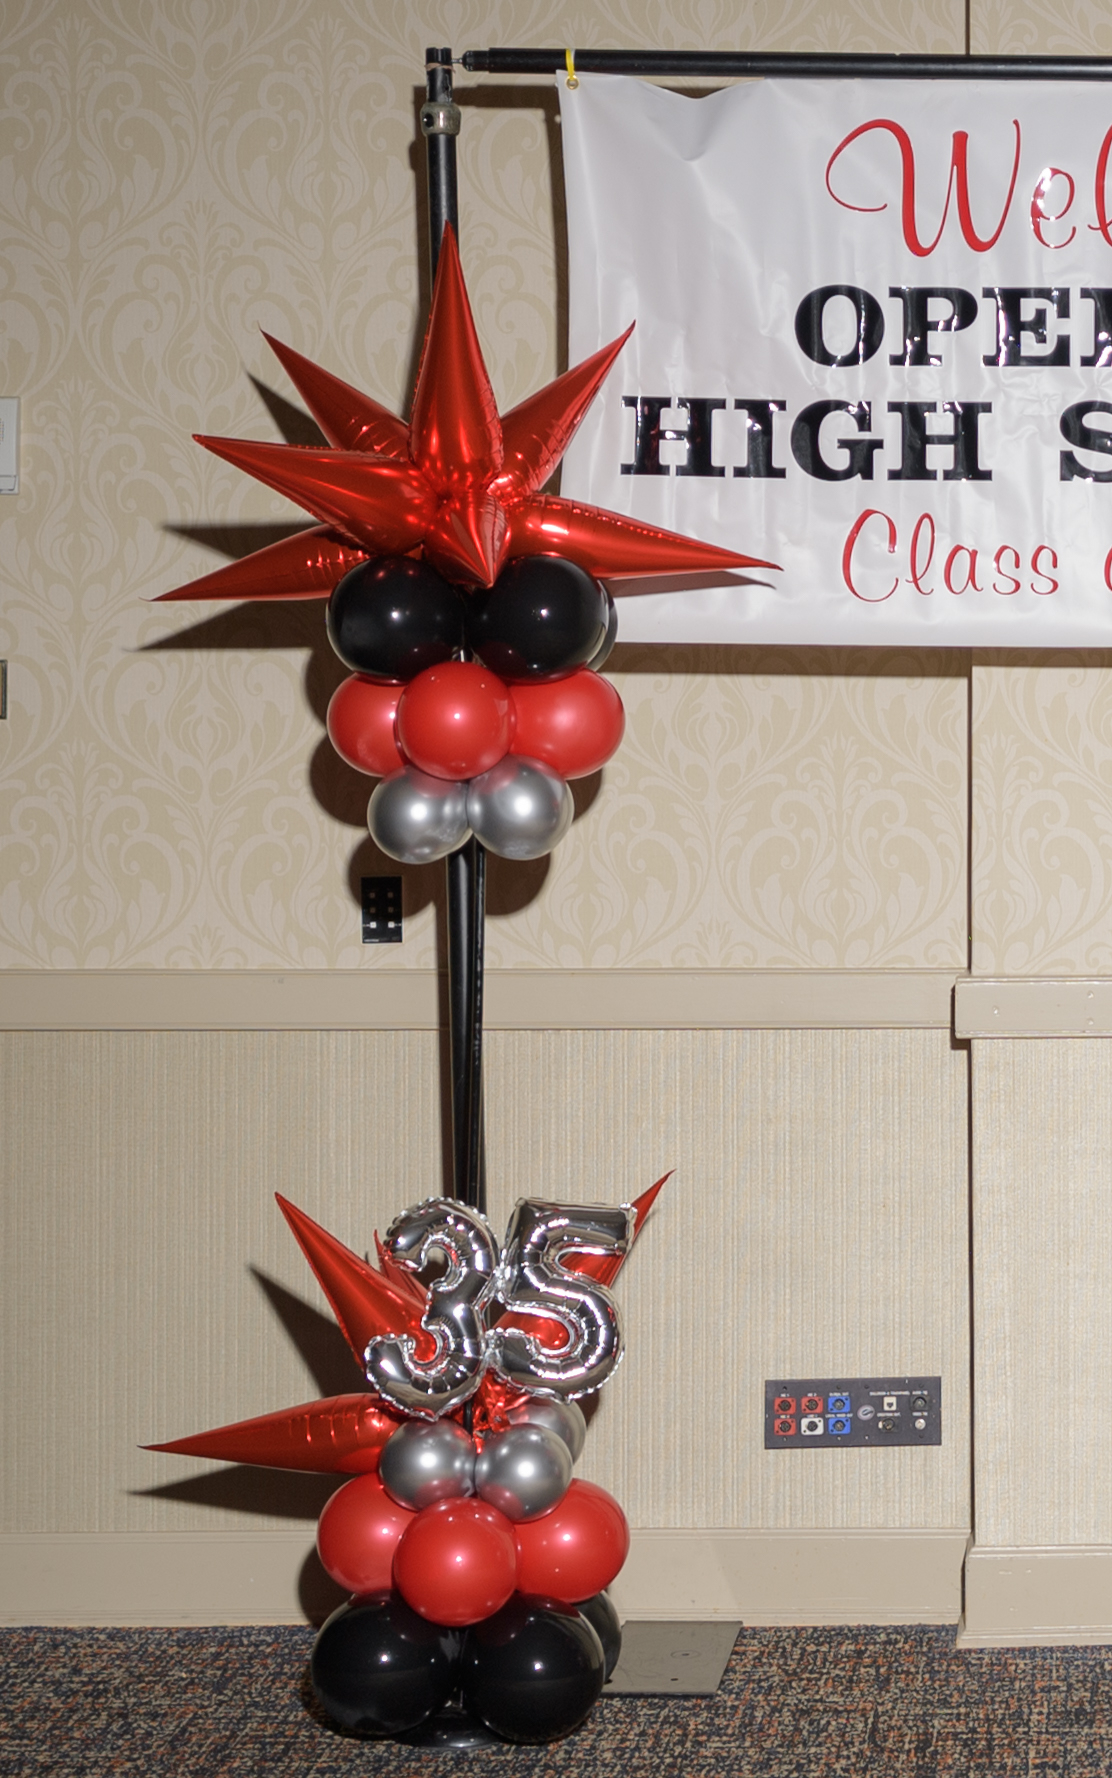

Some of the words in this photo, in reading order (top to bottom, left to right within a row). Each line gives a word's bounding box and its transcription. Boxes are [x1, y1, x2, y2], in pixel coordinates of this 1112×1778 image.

[619, 396, 993, 482] HIGH
[841, 508, 1060, 602] Class
[364, 1196, 637, 1422] 35
